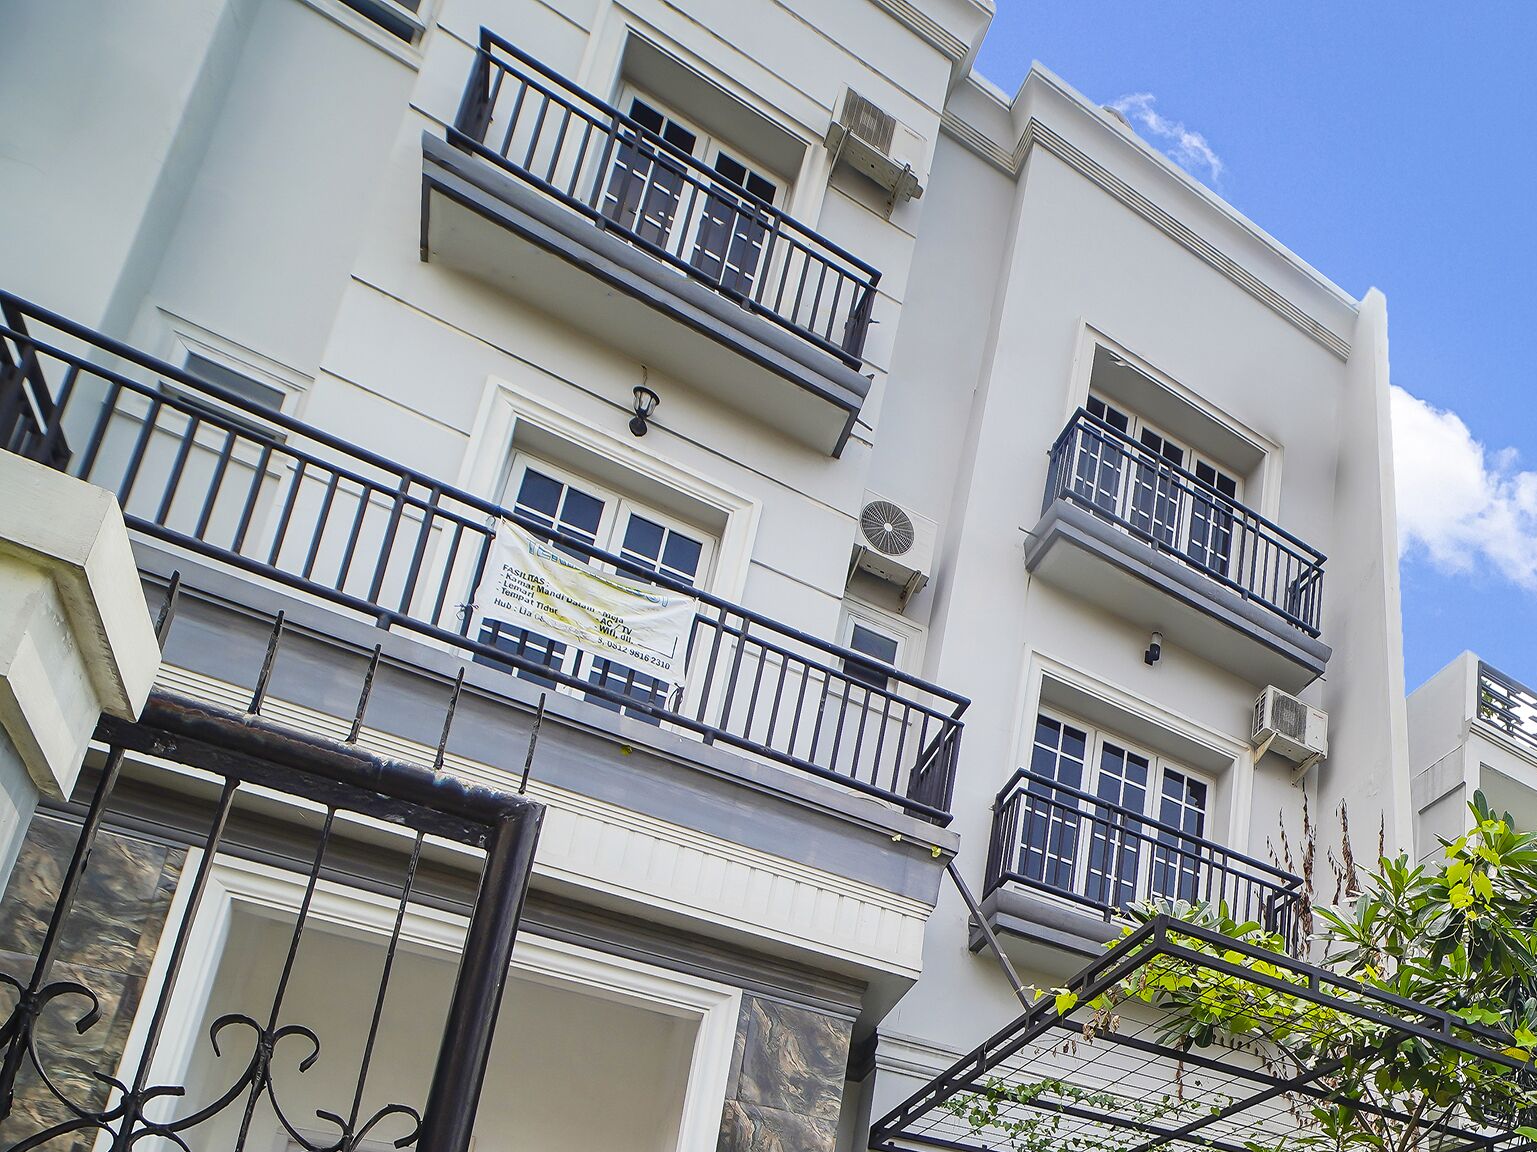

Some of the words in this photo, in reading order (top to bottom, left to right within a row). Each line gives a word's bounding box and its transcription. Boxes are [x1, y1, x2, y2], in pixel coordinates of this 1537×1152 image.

[503, 564, 545, 585] FASILITAS
[501, 587, 534, 606] Tempat
[503, 580, 535, 598] Lemari
[505, 573, 535, 590] Kamar
[536, 586, 564, 601] Mandi
[494, 598, 512, 610] Hub
[519, 606, 532, 617] Lia
[600, 618, 613, 627] AC
[622, 625, 632, 635] TV
